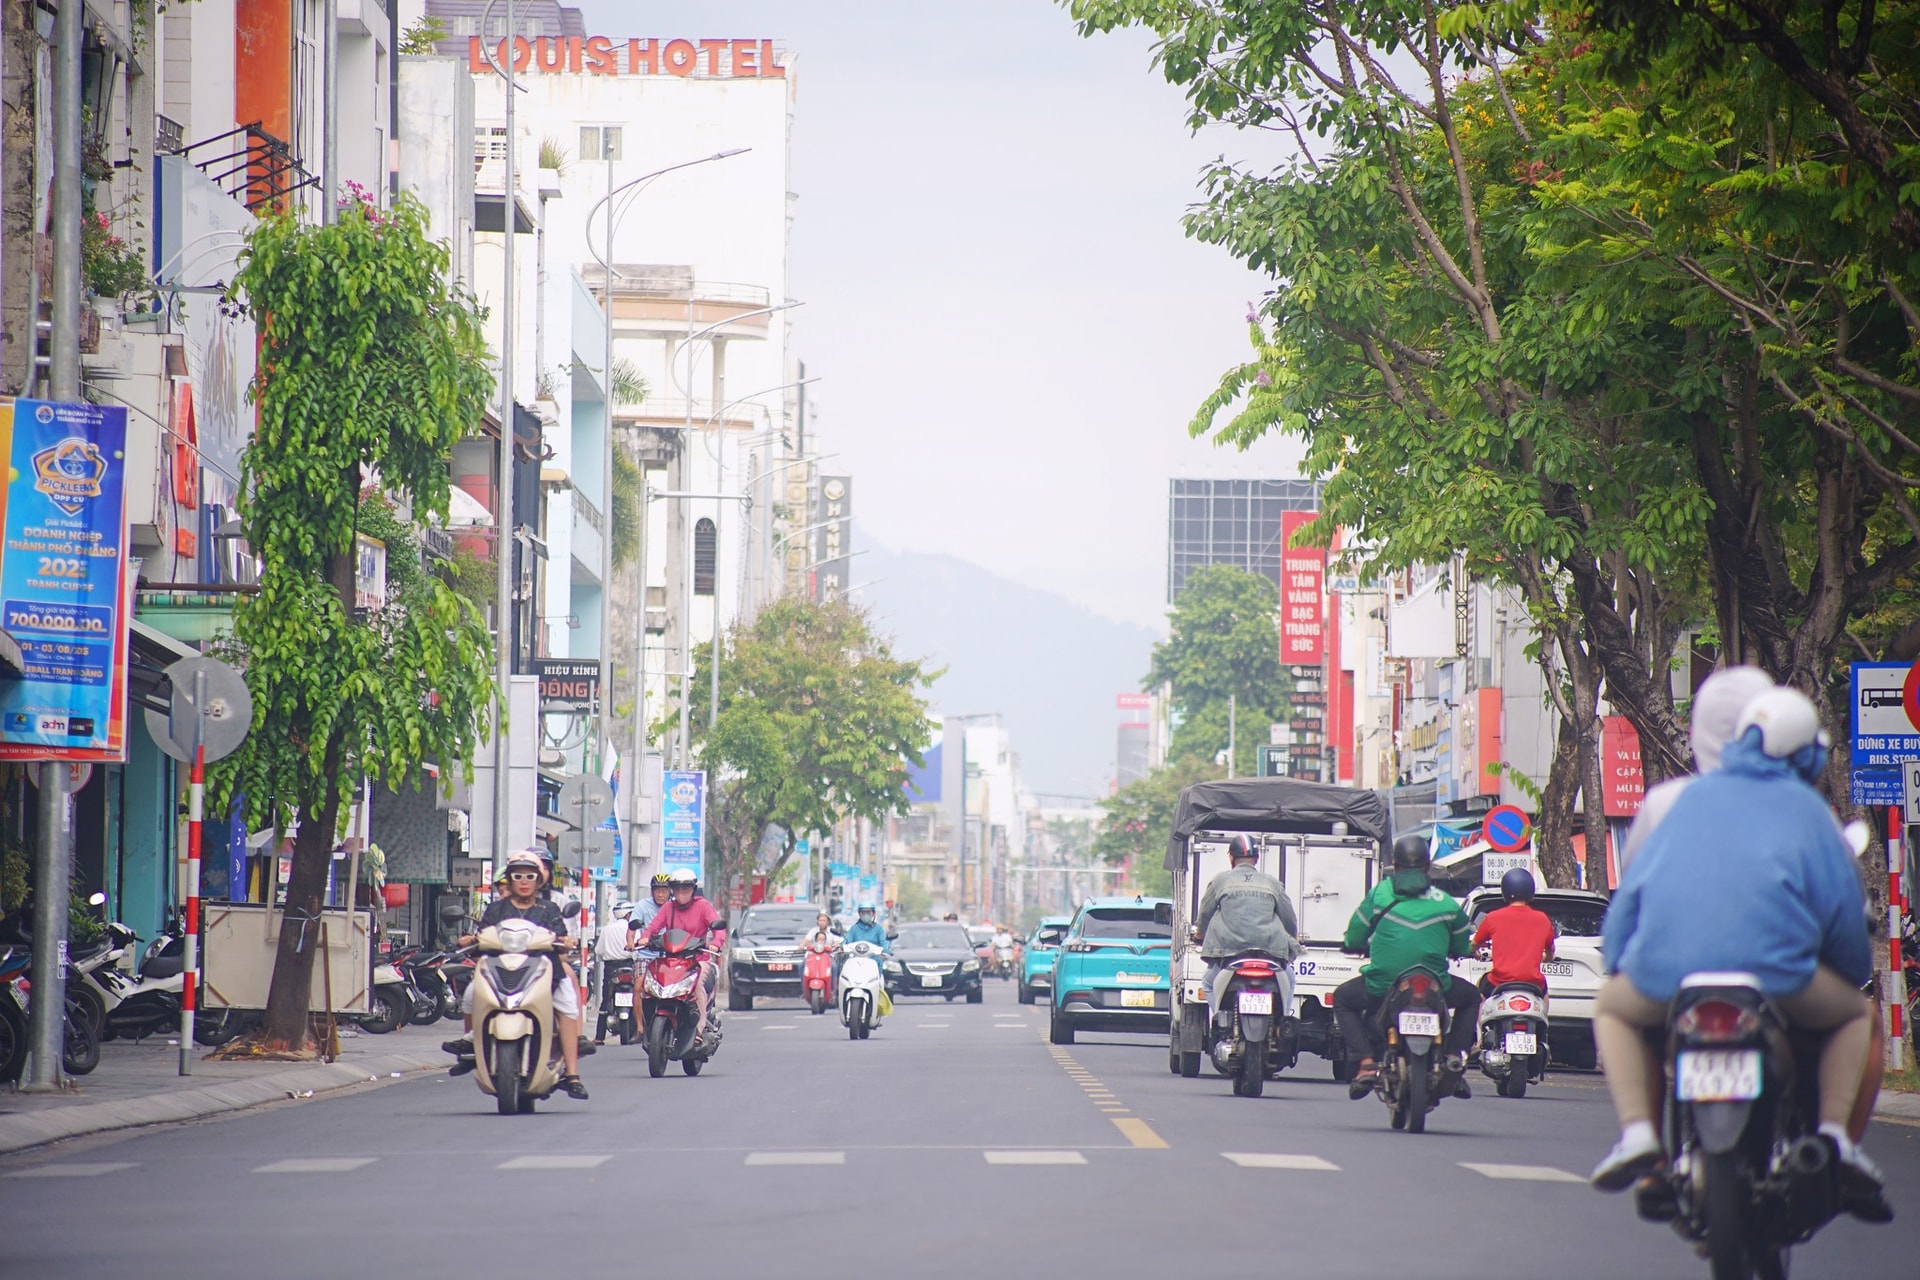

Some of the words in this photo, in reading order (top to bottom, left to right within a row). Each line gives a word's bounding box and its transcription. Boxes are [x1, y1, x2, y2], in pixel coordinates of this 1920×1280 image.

[469, 36, 617, 76] LOUIS
[629, 38, 785, 76] HOTEL
[23, 527, 67, 539] DOANH
[69, 528, 103, 542] NGIỆP
[8, 538, 46, 552] THÀNH
[48, 540, 73, 554] PHỐ
[1285, 559, 1321, 571] TRUNG
[26, 578, 60, 590] TRANH
[1291, 573, 1315, 588] TÂM
[1287, 589, 1318, 604] VÀNG
[1291, 606, 1314, 623] BẠC
[1291, 638, 1314, 652] SỨC
[544, 664, 570, 677] HIỆU
[572, 664, 598, 676] KÍNH
[42, 719, 66, 730] adm
[1857, 736, 1886, 750] DỪNG
[1888, 738, 1901, 751] XE
[1616, 751, 1630, 760] VA
[1869, 754, 1890, 765] BUS
[1487, 859, 1505, 868] 06:30
[1510, 859, 1528, 868] 08:00
